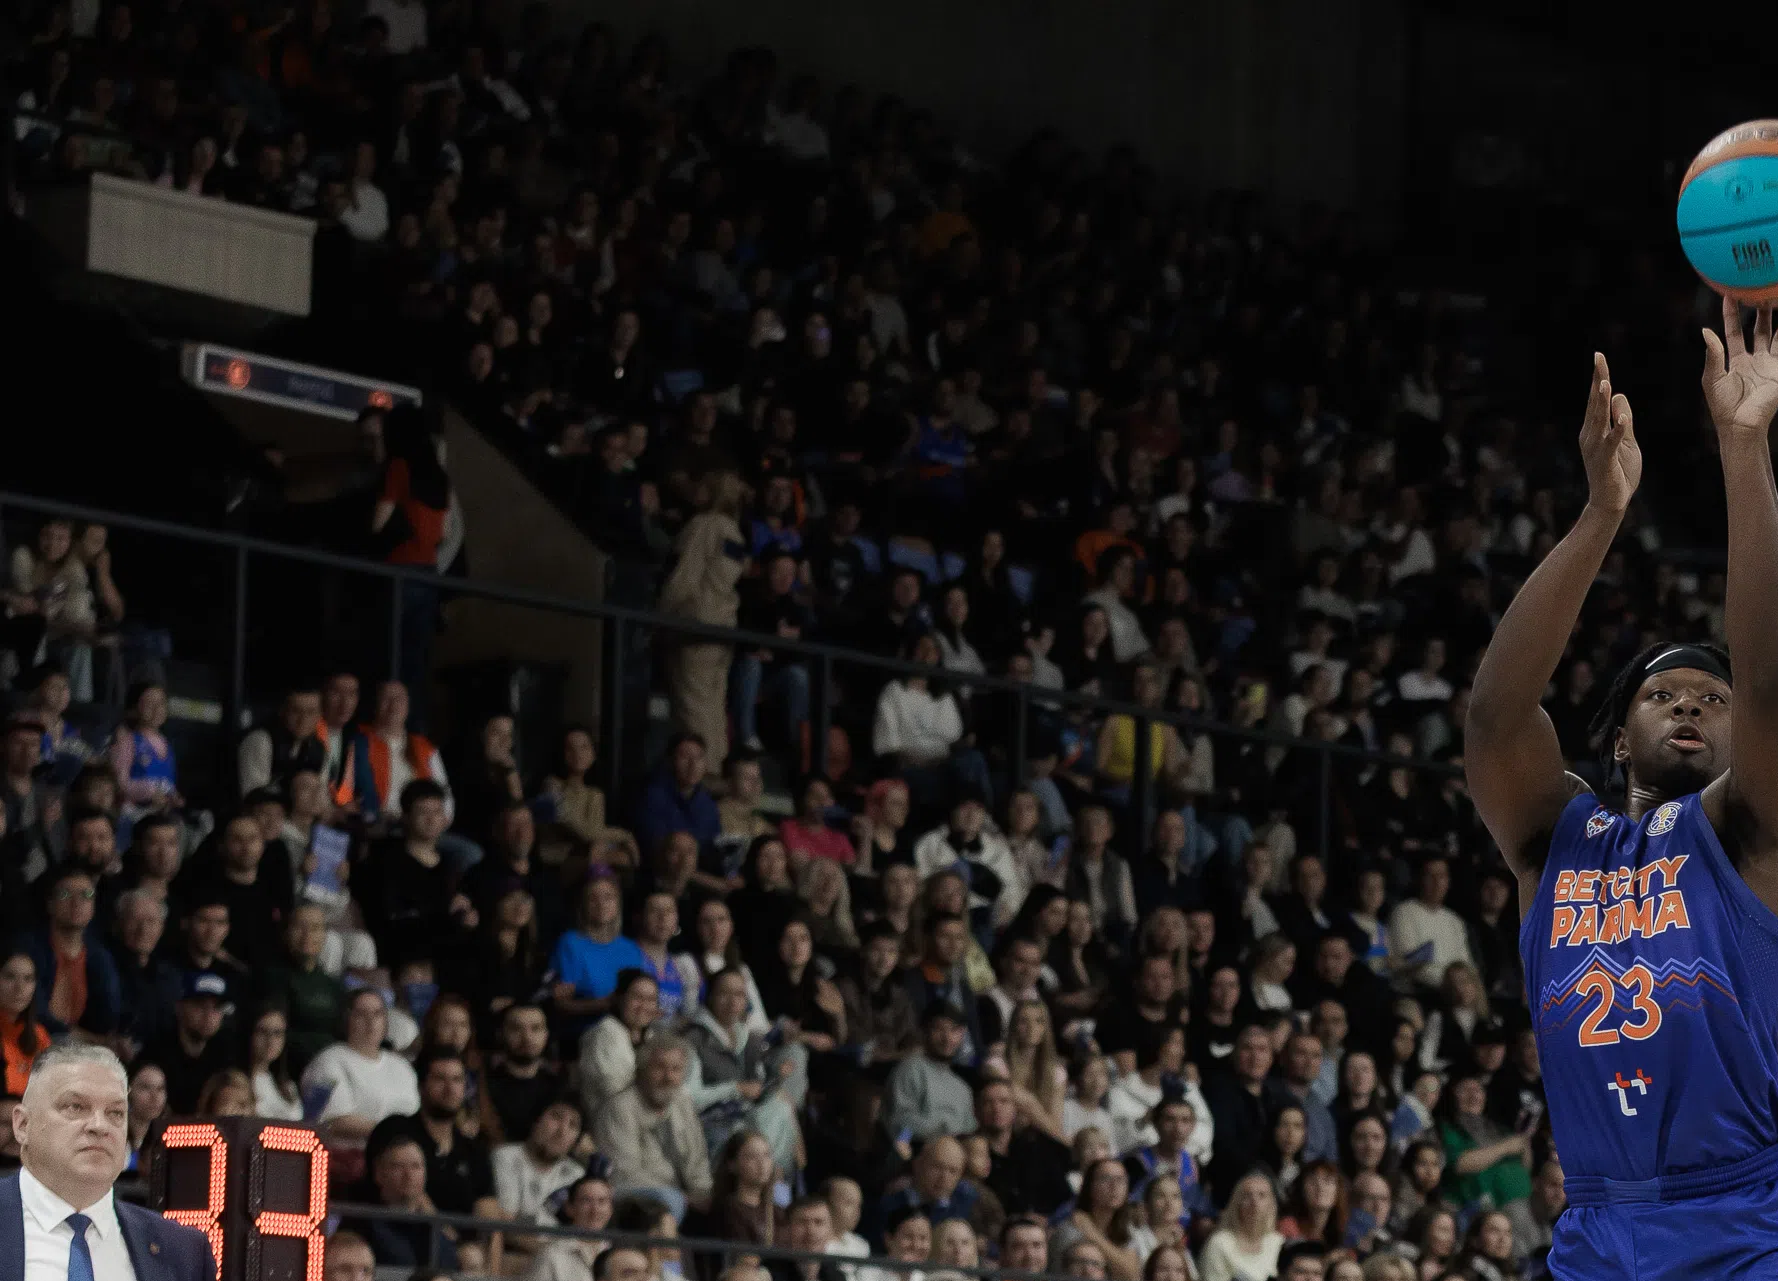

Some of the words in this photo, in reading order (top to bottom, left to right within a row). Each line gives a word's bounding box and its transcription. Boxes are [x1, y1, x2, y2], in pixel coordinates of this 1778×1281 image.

[1553, 854, 1689, 903] BETCITY
[1550, 890, 1691, 949] PARMA
[1576, 964, 1662, 1047] 23
